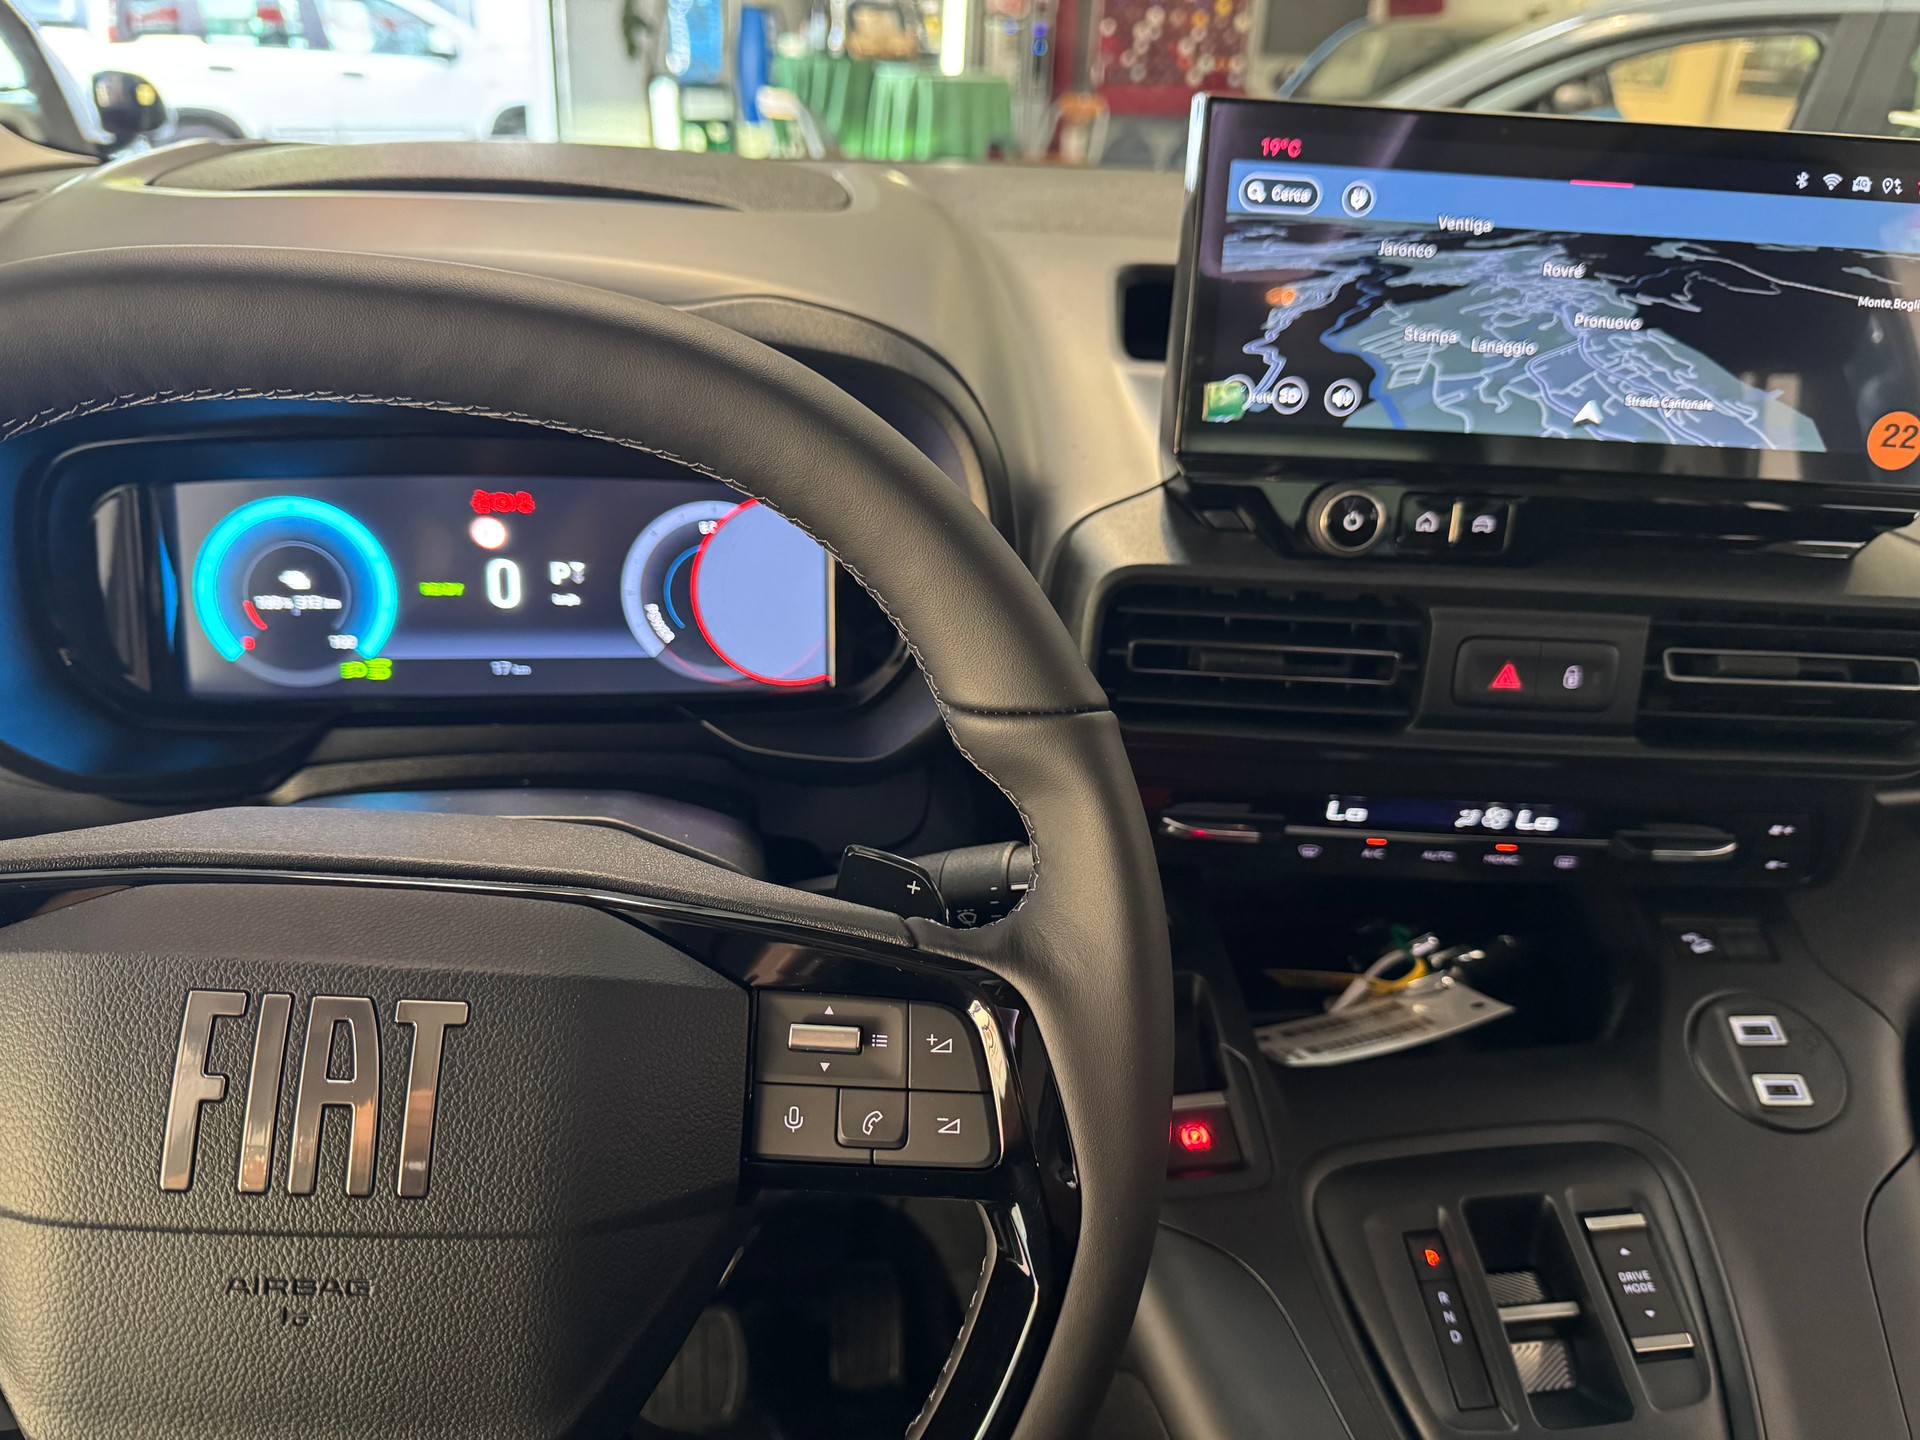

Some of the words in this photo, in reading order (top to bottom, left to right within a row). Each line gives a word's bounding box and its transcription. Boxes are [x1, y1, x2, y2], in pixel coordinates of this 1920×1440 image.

[1438, 215, 1494, 236] Ventiga
[1858, 296, 1892, 309] Monte
[1574, 312, 1643, 331] Pronuovo
[1404, 325, 1460, 346] Stampa
[1881, 423, 1919, 449] 22
[486, 558, 521, 610] 0
[160, 989, 470, 1199] FIAT
[1617, 1269, 1651, 1283] DRIVE
[225, 1277, 371, 1296] AIRBAG
[1623, 1281, 1656, 1295] MODE
[1443, 1310, 1457, 1324] N
[1449, 1330, 1463, 1345] D
